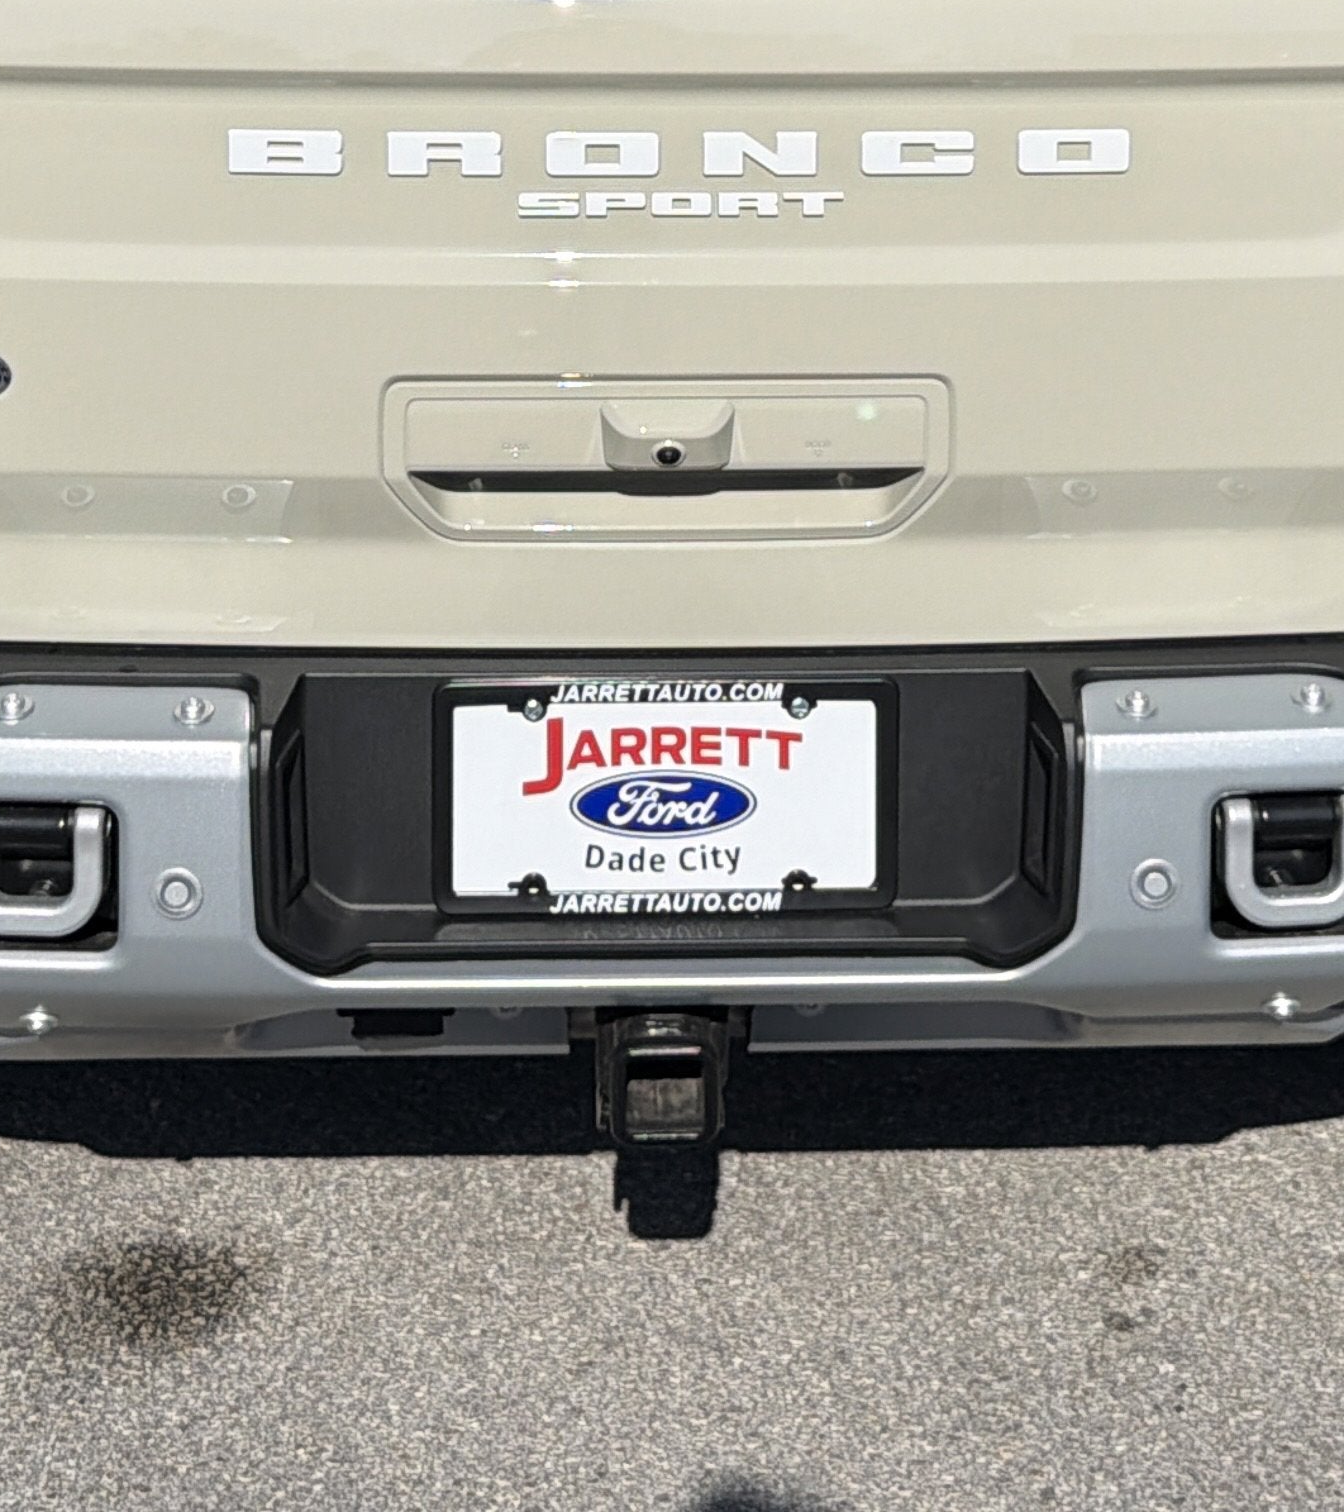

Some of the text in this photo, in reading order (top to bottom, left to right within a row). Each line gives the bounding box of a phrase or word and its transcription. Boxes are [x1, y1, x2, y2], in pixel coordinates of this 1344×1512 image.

[227, 127, 1131, 177] BRONCO
[516, 190, 845, 218] SPORT
[549, 682, 785, 704] JARRETTAUTO.COM
[522, 716, 803, 797] JARRETT
[606, 779, 720, 826] Ford
[584, 843, 742, 876] Dade City
[548, 891, 784, 914] JARRETTAUTO.COM
